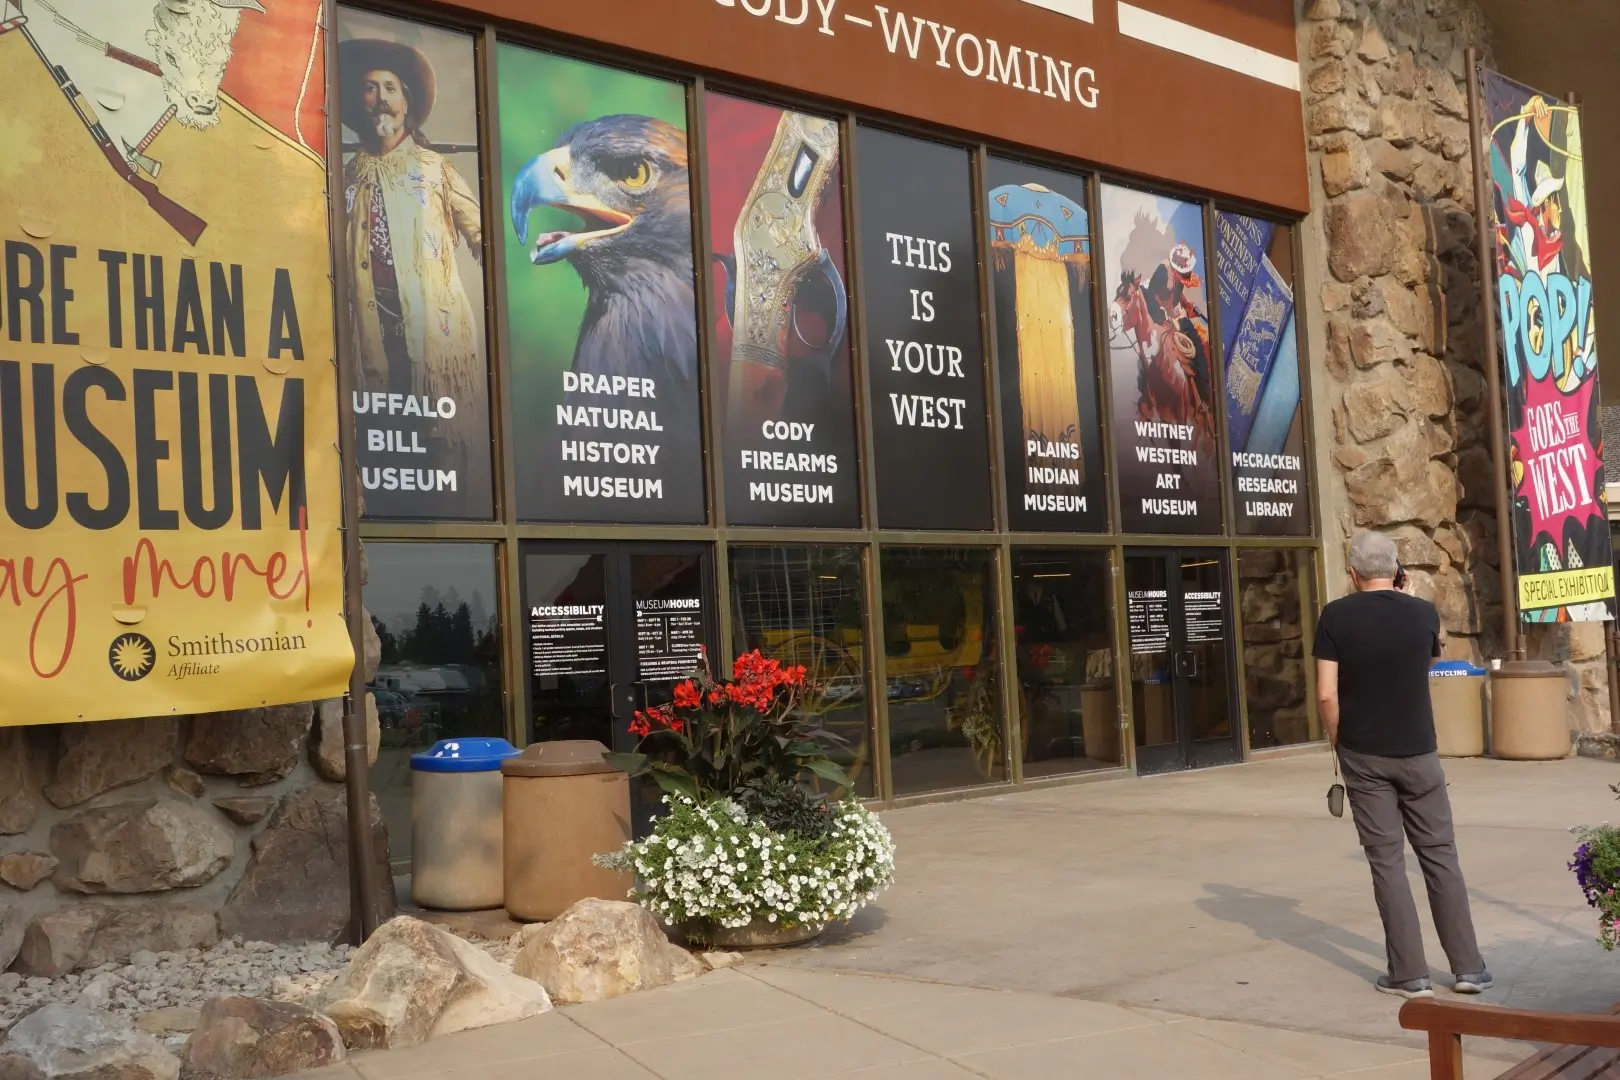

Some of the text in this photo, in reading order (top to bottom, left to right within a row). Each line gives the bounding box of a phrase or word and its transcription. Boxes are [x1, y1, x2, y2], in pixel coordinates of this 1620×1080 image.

[886, 232, 952, 273] THIS
[0, 240, 305, 361] RE THAN A
[910, 288, 935, 323] IS
[1499, 271, 1592, 387] POP!
[885, 339, 965, 378] YOUR
[562, 371, 656, 399] DRAPER
[556, 404, 664, 431] NATURAL
[889, 393, 966, 430] WEST
[762, 420, 815, 442] CODY
[1134, 420, 1194, 441] WHITNEY
[1527, 400, 1580, 453] GOES THE
[367, 429, 427, 453] BILL
[561, 440, 660, 465] HISTORY
[1027, 440, 1080, 460] PLAINS
[740, 450, 838, 474] FIREARMS
[1136, 446, 1197, 466] WESTERN
[563, 475, 663, 499] MUSEUM
[1028, 466, 1079, 485] INDIAN
[1155, 474, 1181, 490] ART
[1238, 476, 1298, 494] RESEARCH
[1528, 443, 1593, 521] WEST
[750, 482, 833, 504] MUSEUM
[1024, 494, 1087, 512] MUSEUM
[1141, 498, 1197, 516] MUSEUM
[1246, 501, 1294, 517] LIBRARY
[122, 506, 313, 628] more!
[1524, 573, 1610, 602] SPECIAL EXHIBITION
[531, 605, 604, 617] ACCESSIBILITY
[168, 633, 306, 656] Smithsonian
[167, 661, 220, 678] Affiliate
